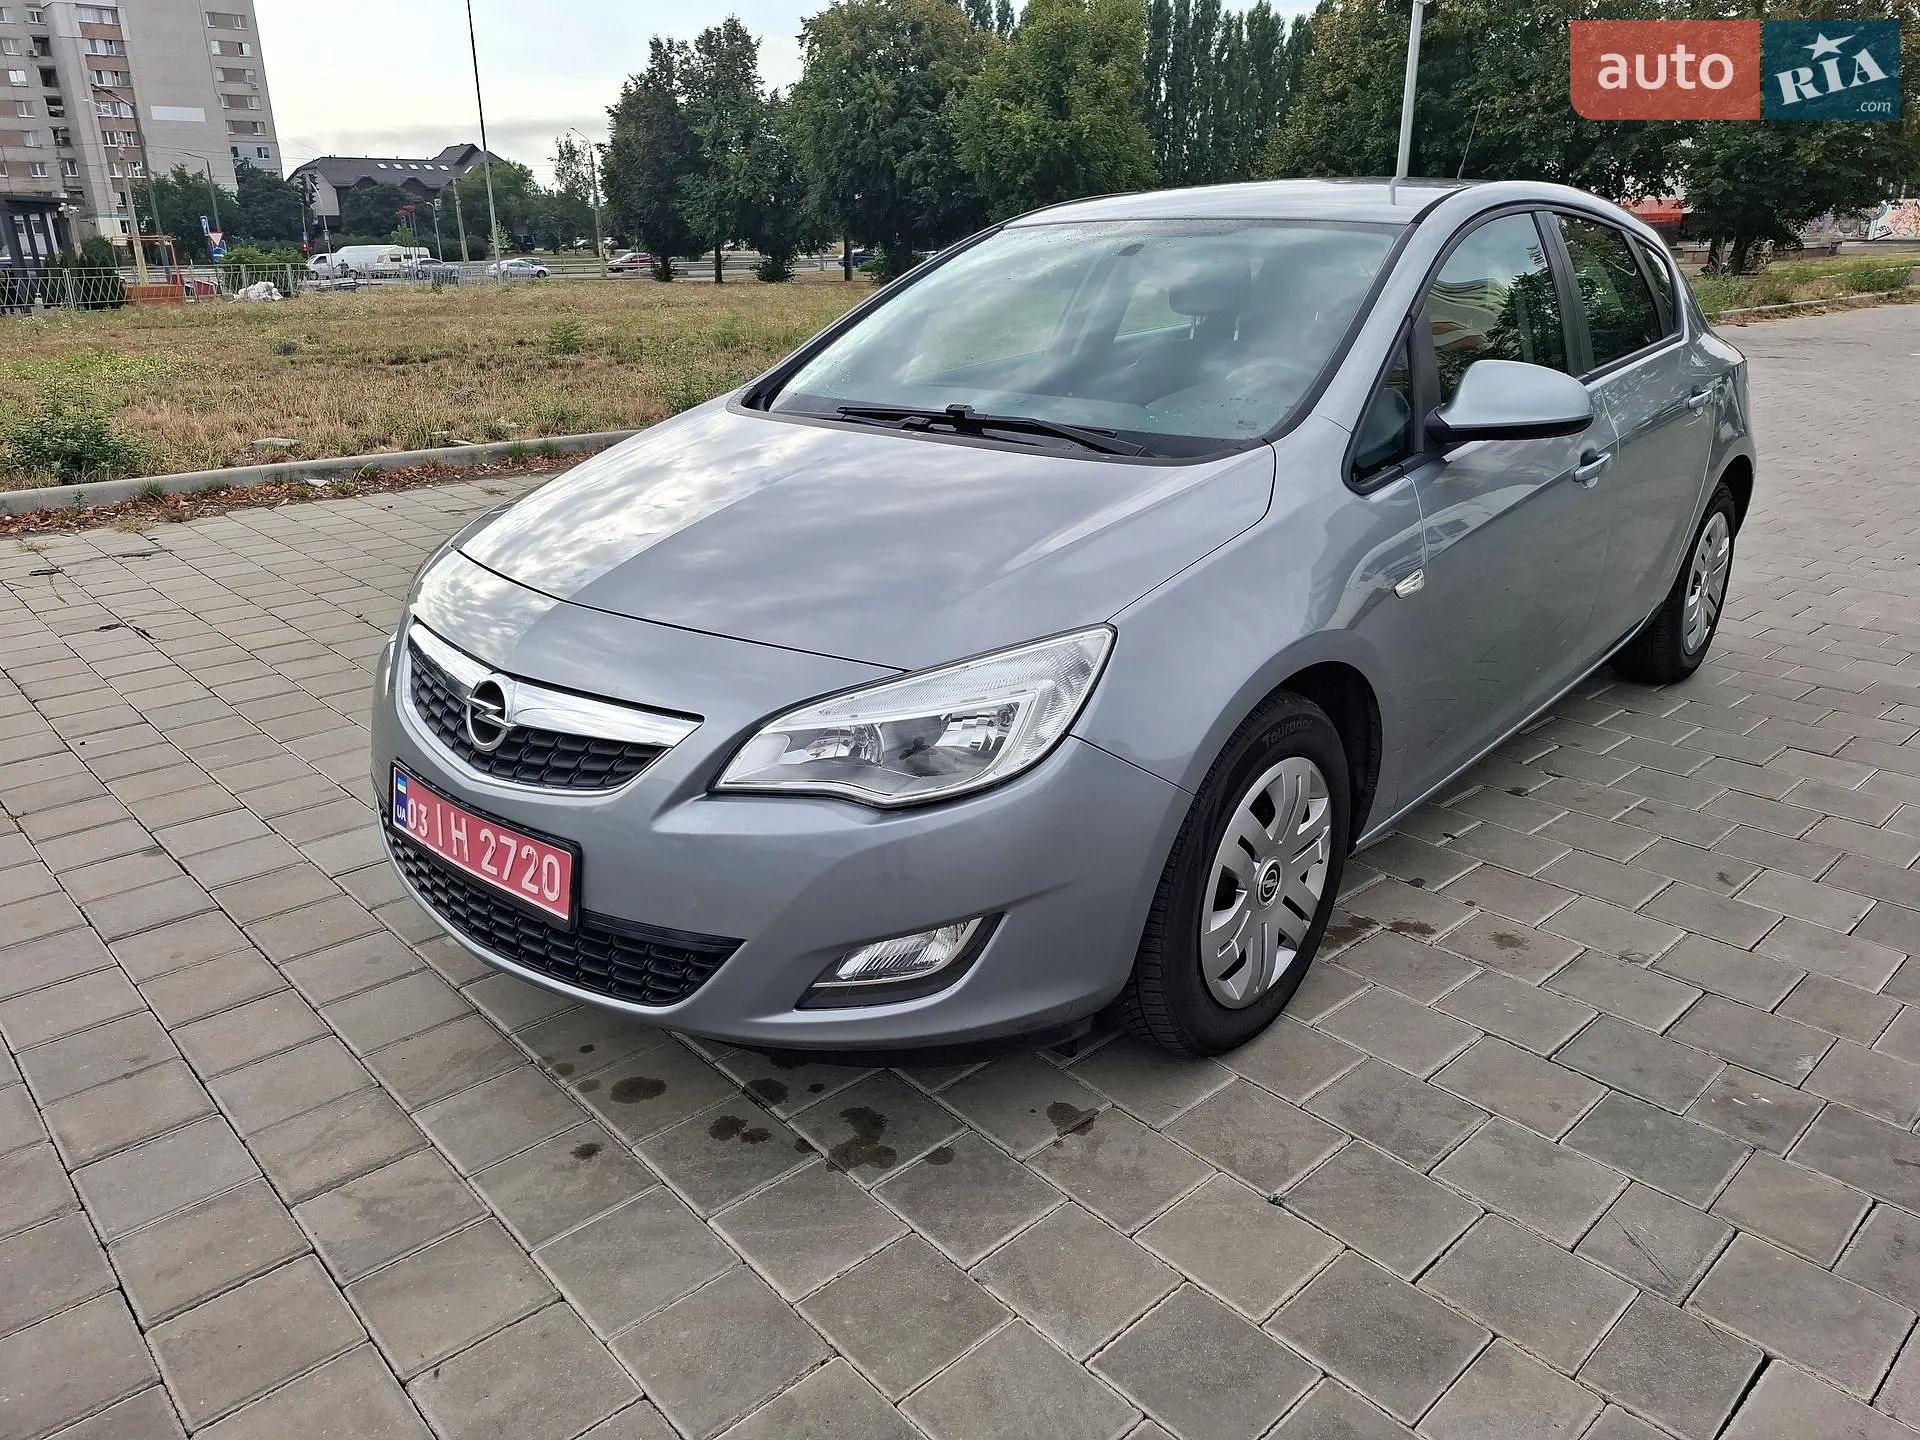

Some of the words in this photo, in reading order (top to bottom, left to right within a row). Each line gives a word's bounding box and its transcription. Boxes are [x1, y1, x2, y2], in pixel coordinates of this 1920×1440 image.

[396, 804, 407, 822] UA
[407, 798, 429, 837] 03
[479, 828, 561, 902] 2720
